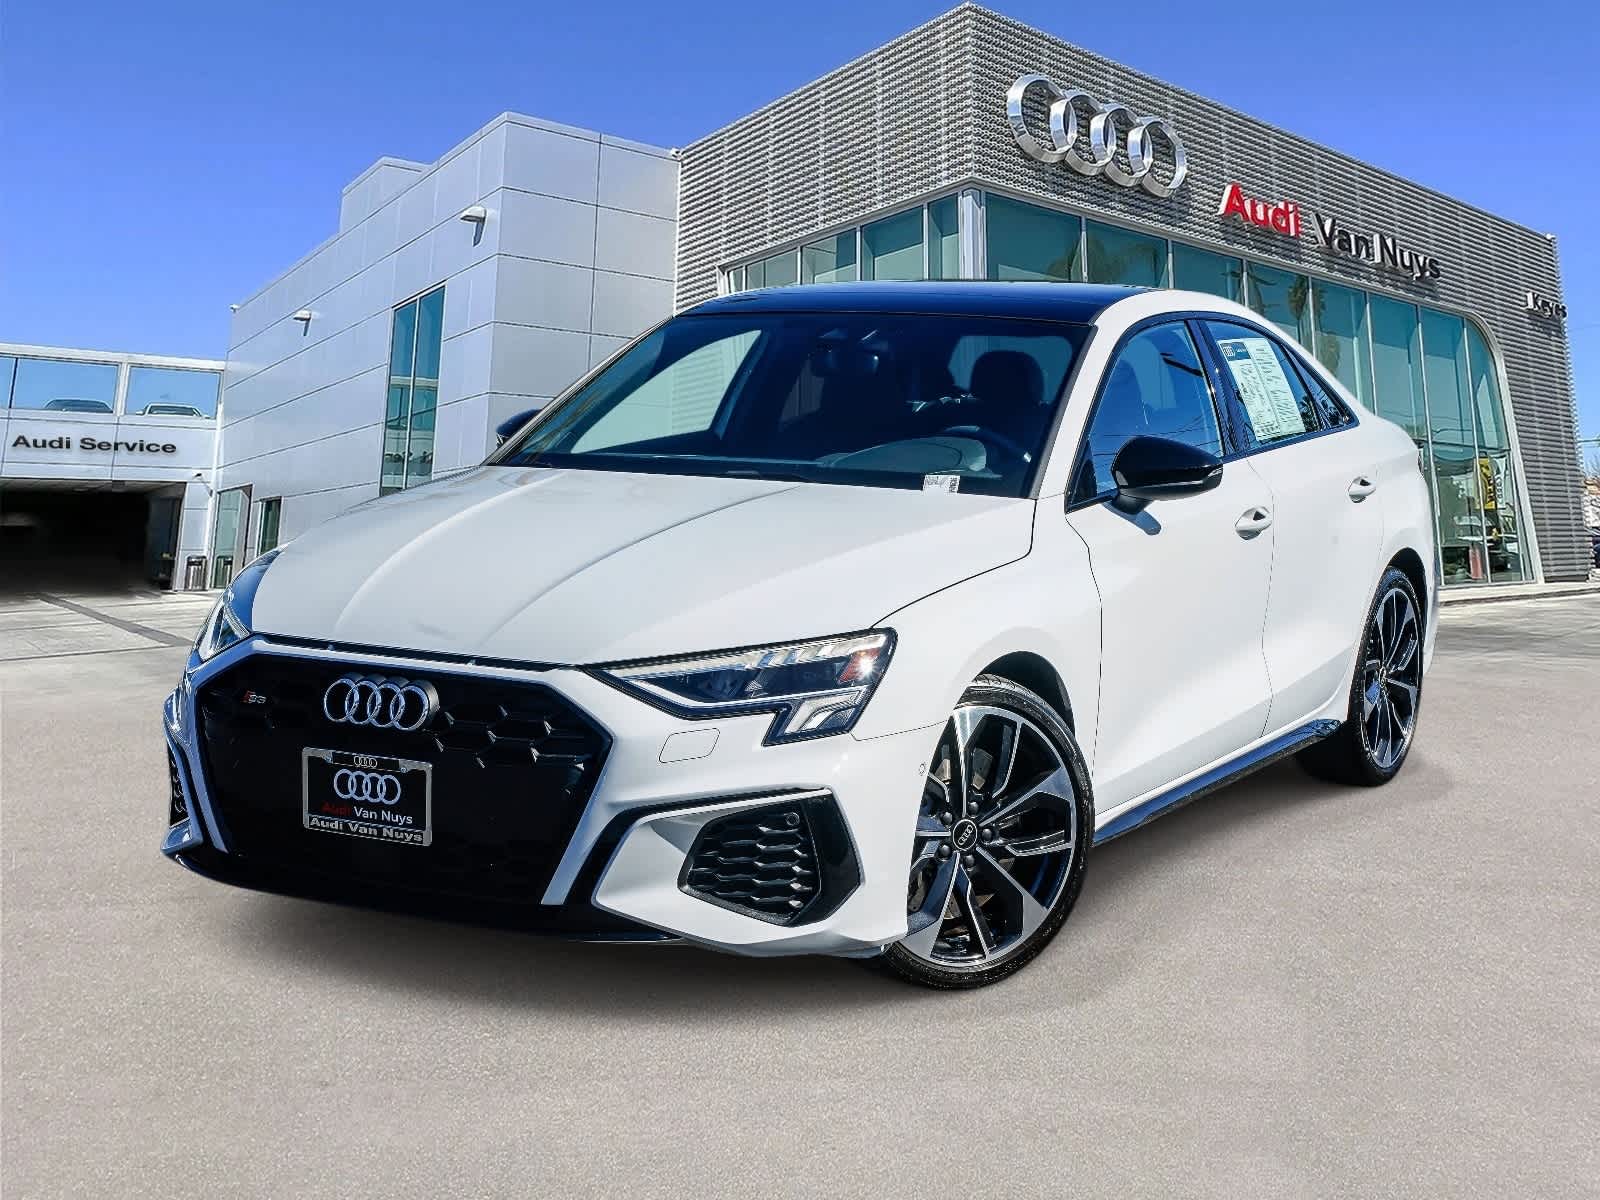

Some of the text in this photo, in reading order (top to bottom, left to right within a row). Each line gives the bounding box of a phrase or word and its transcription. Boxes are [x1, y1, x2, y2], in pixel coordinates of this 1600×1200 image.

[1219, 182, 1441, 281] Audi Van Nuys
[12, 435, 177, 454] Audi Service
[322, 802, 413, 826] Audi Van Nuys
[309, 816, 424, 842] Audi Van Nuys
